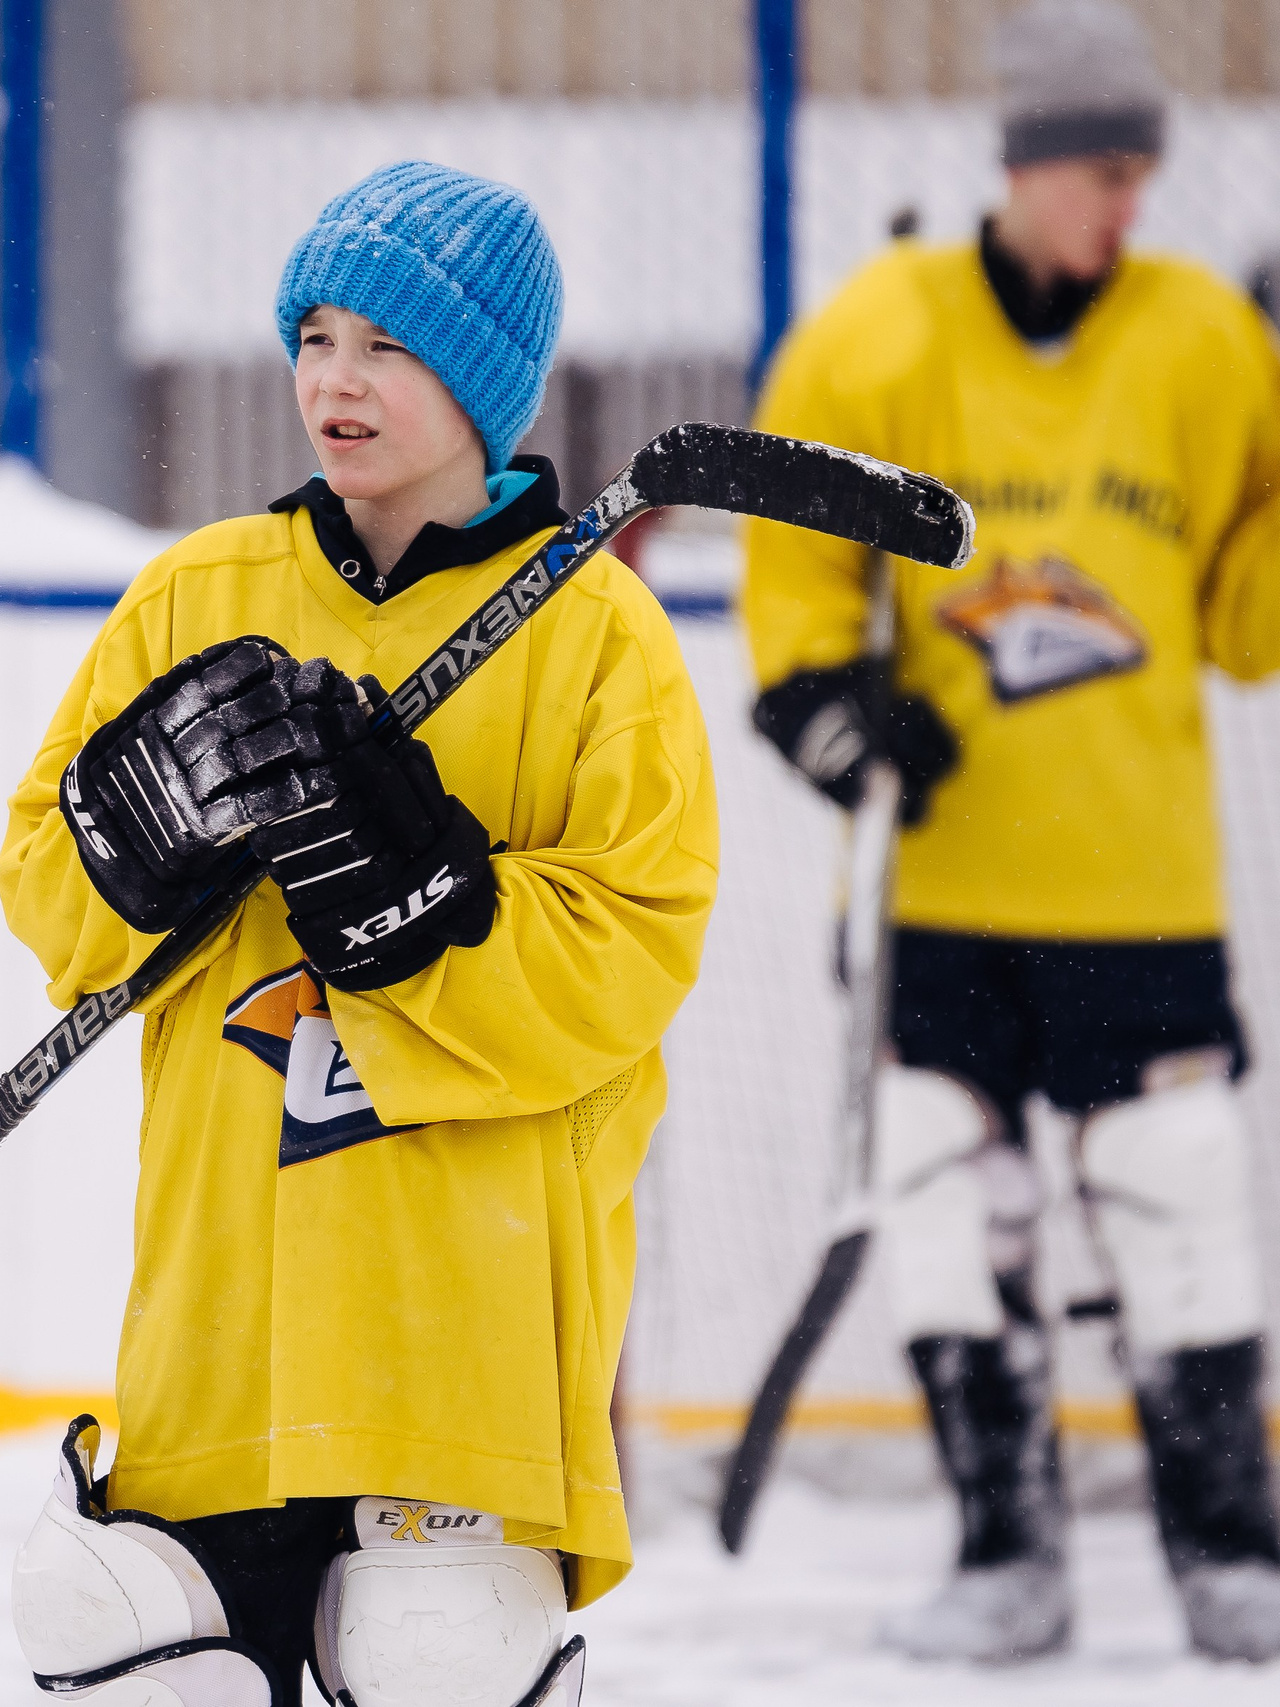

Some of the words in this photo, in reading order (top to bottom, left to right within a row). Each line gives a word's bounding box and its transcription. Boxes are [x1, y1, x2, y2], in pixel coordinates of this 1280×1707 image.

[391, 558, 553, 729] NEXUS
[66, 749, 118, 860] STE
[340, 864, 454, 951] STEX
[376, 1505, 483, 1544] EXON
